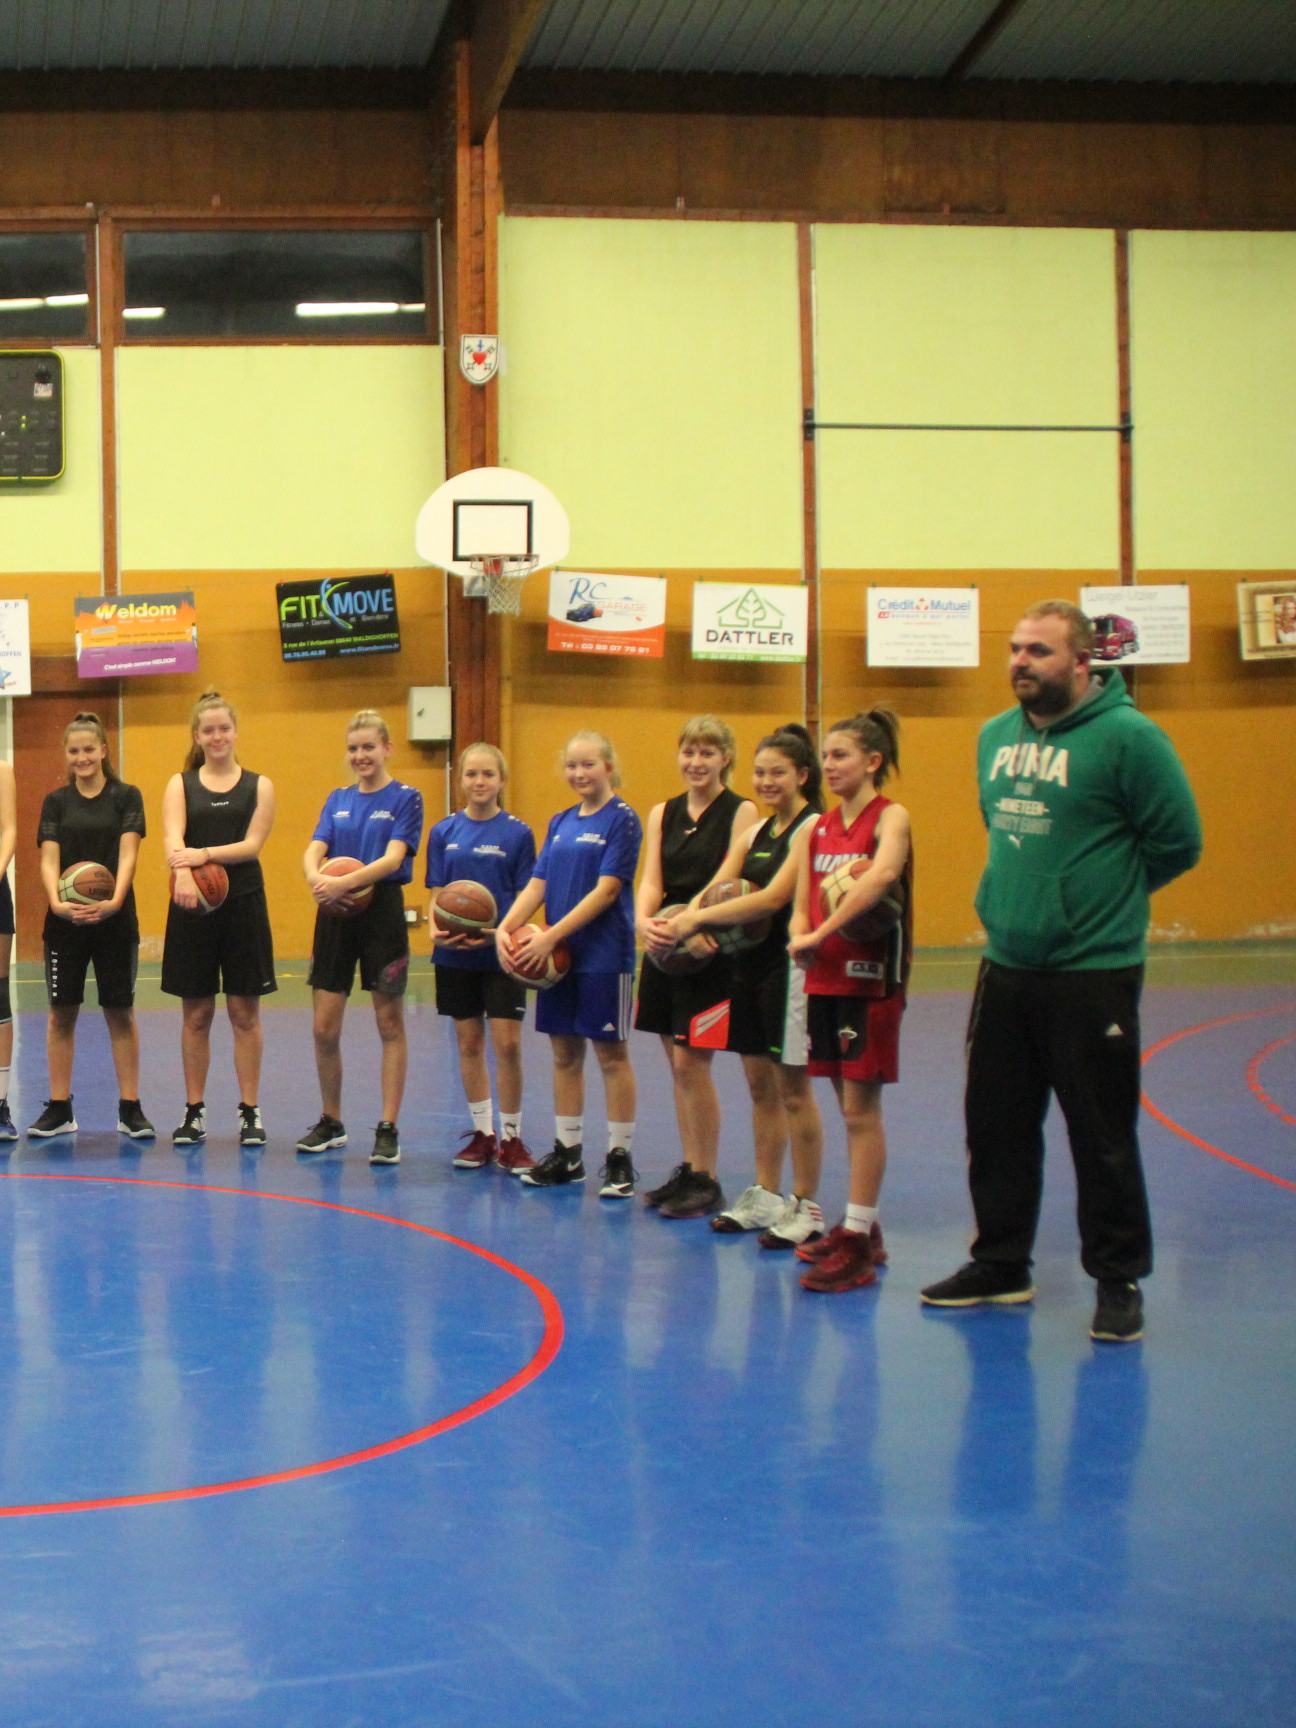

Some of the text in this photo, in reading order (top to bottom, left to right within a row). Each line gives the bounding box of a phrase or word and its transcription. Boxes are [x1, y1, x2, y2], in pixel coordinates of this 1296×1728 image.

[569, 577, 608, 605] RC
[94, 602, 177, 620] Weldom
[280, 588, 395, 621] FIT MOVE
[878, 598, 971, 611] Crédit Mutuel
[705, 629, 794, 646] DATTLER
[151, 657, 177, 666] WELDOM
[988, 742, 1069, 788] PUMA
